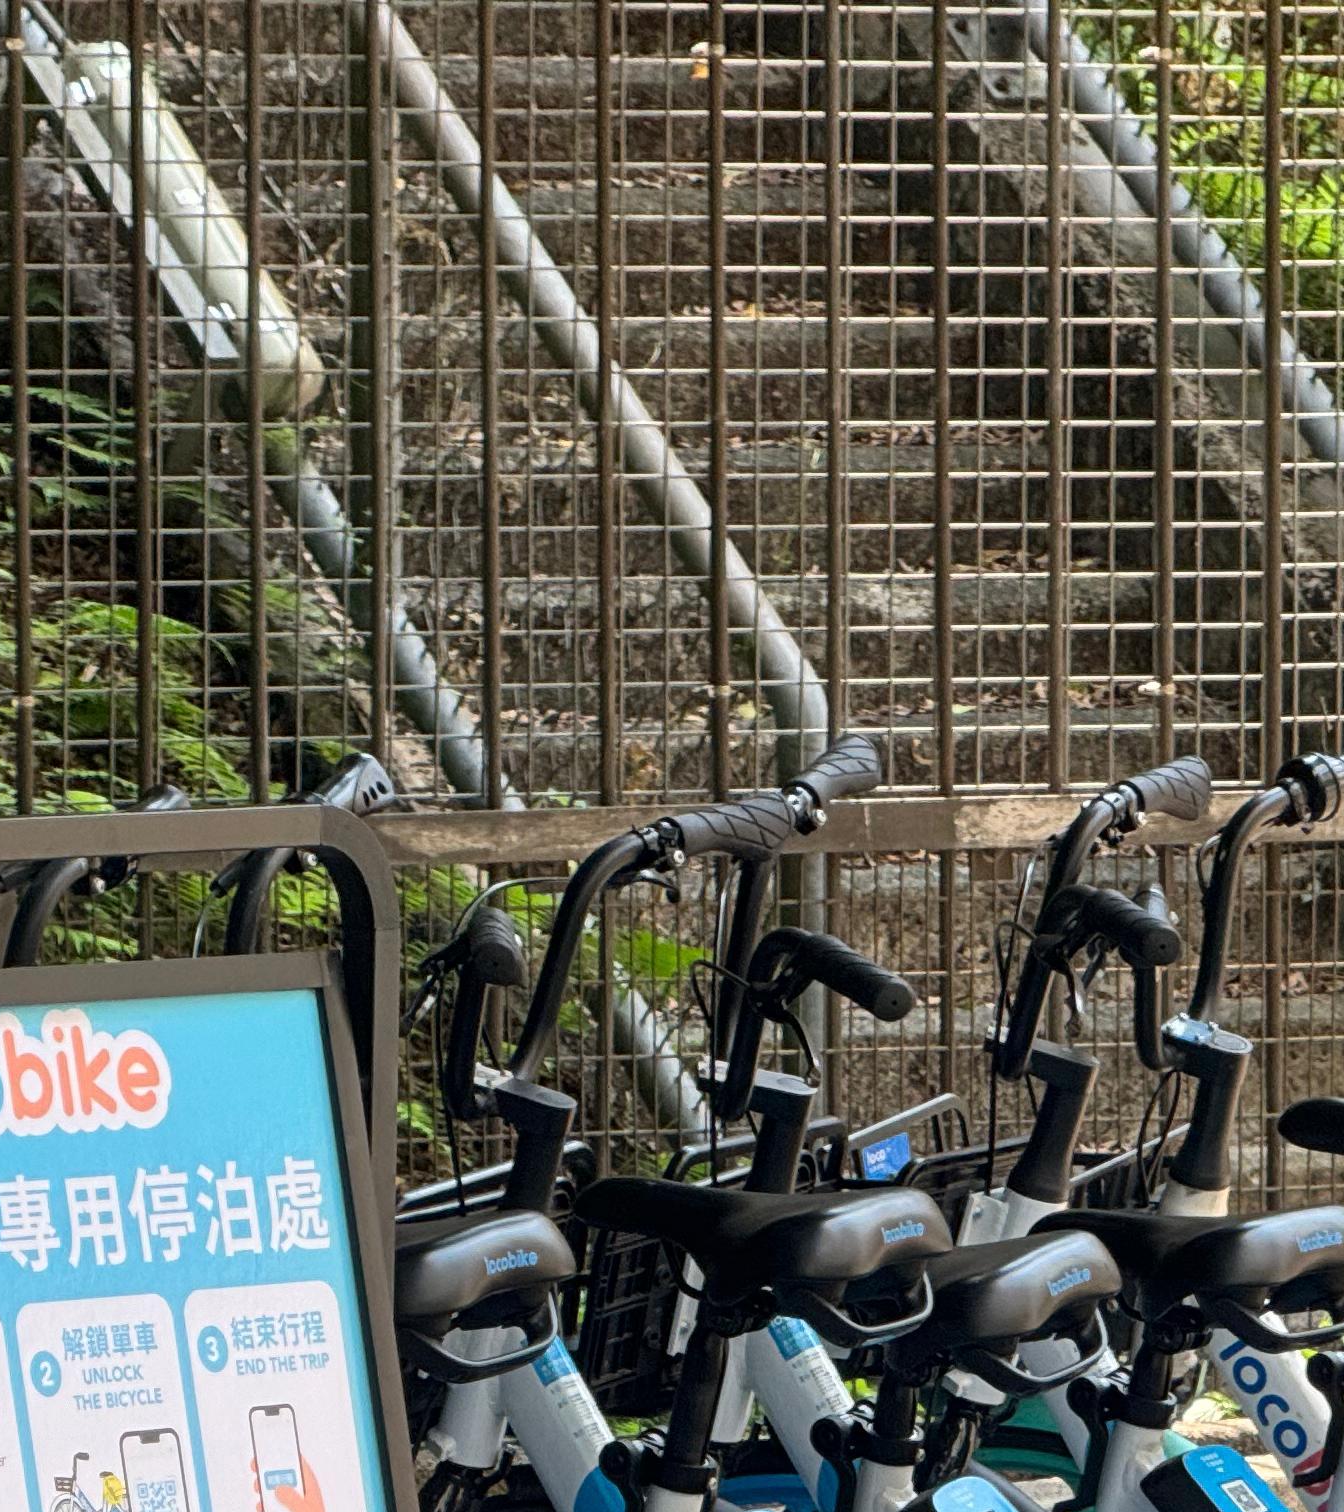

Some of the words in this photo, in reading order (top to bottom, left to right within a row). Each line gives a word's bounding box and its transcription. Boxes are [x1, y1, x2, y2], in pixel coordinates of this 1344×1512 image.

[482, 1248, 539, 1276] locobike
[60, 1320, 159, 1361] 解鎖單車
[229, 1309, 326, 1351] 結束行程
[80, 1363, 145, 1386] UNLOCK
[234, 1356, 267, 1376] END
[267, 1354, 298, 1373] THE
[298, 1351, 330, 1370] TRIP
[71, 1391, 103, 1411] THE
[103, 1386, 164, 1409] BICYCLE
